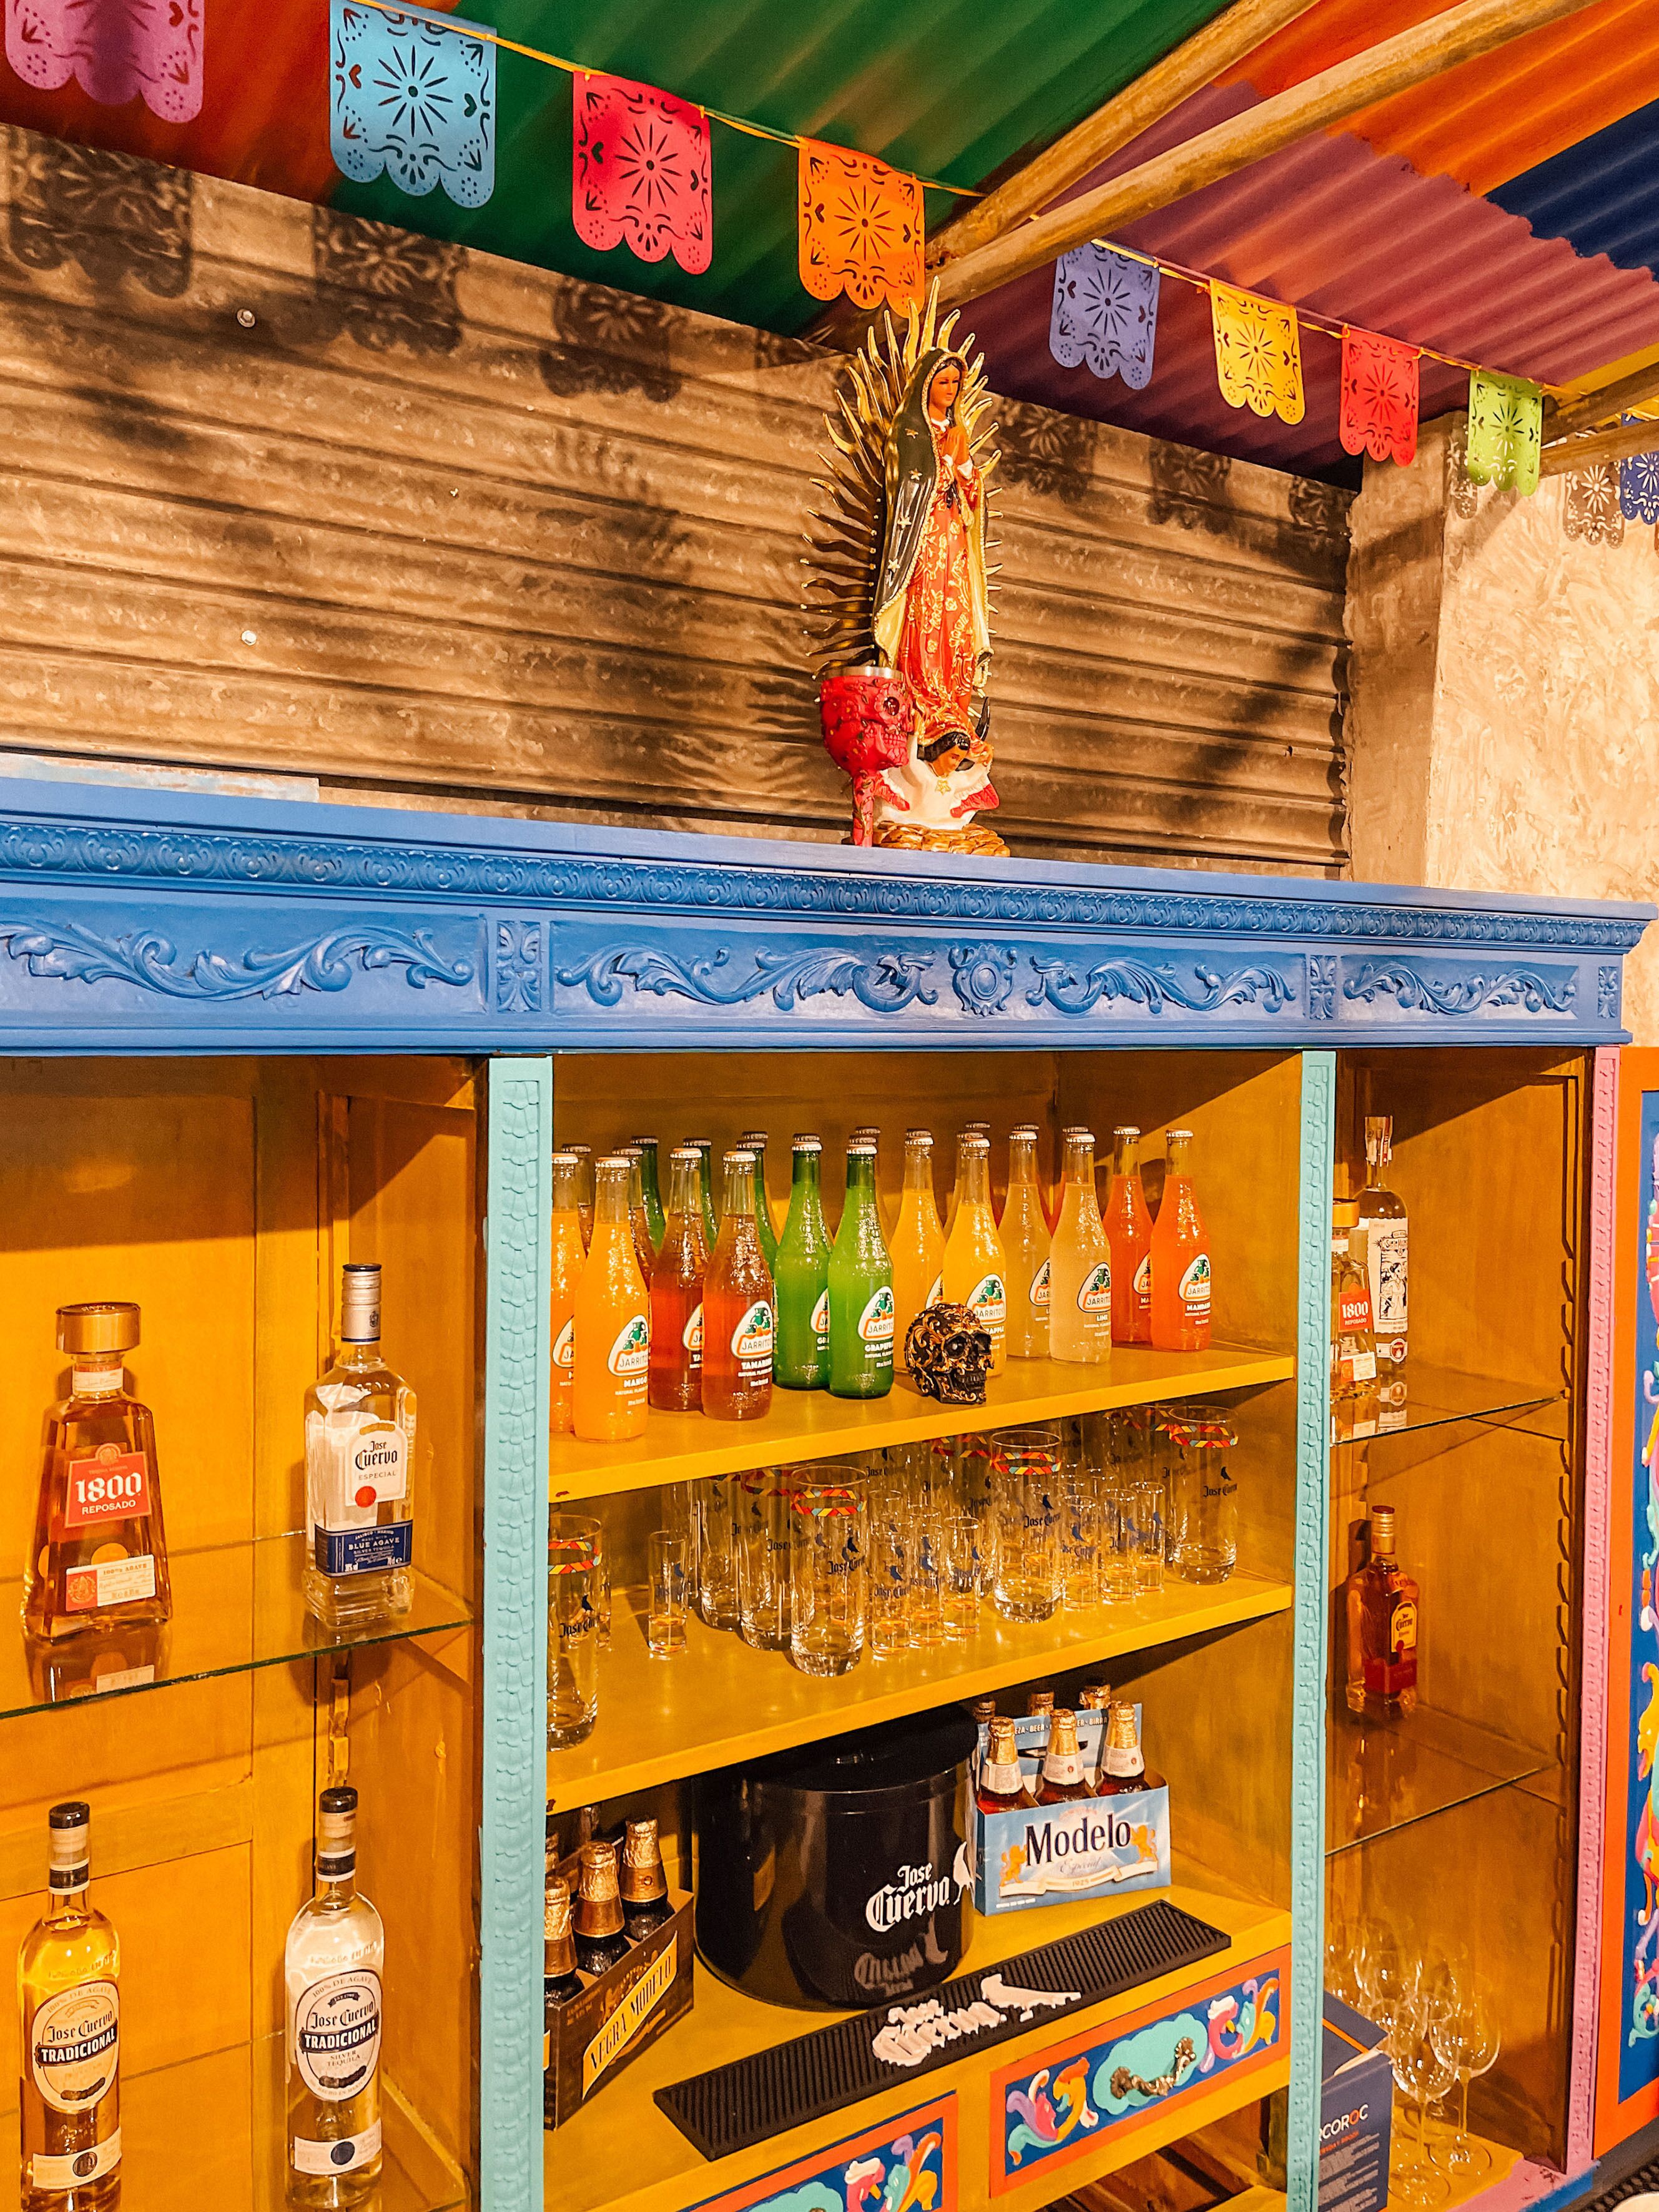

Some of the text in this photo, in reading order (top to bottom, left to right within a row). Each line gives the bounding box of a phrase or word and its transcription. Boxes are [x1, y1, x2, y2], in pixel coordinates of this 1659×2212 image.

[1341, 1301, 1369, 1319] 1800
[355, 1449, 398, 1470] Cuervo
[369, 1440, 387, 1452] Jose
[75, 1472, 142, 1504] 1800
[358, 1470, 396, 1480] ESPECIAL
[81, 1500, 136, 1515] REPOSADO
[348, 1537, 400, 1551] BLUE AGAVE
[1025, 1813, 1131, 1867] Modelo
[897, 1862, 933, 1893] Jose
[865, 1876, 950, 1932] Cuervo
[47, 2010, 112, 2043] Jose Cuervo
[310, 2001, 374, 2029] Jose Cuervo
[590, 1955, 671, 2070] NEGRA MODELO
[41, 2027, 115, 2063] TRADICIONAL
[304, 2018, 376, 2049] TRADICIONAL
[327, 2055, 361, 2067] TEQUILA
[330, 2050, 357, 2060] SILVER
